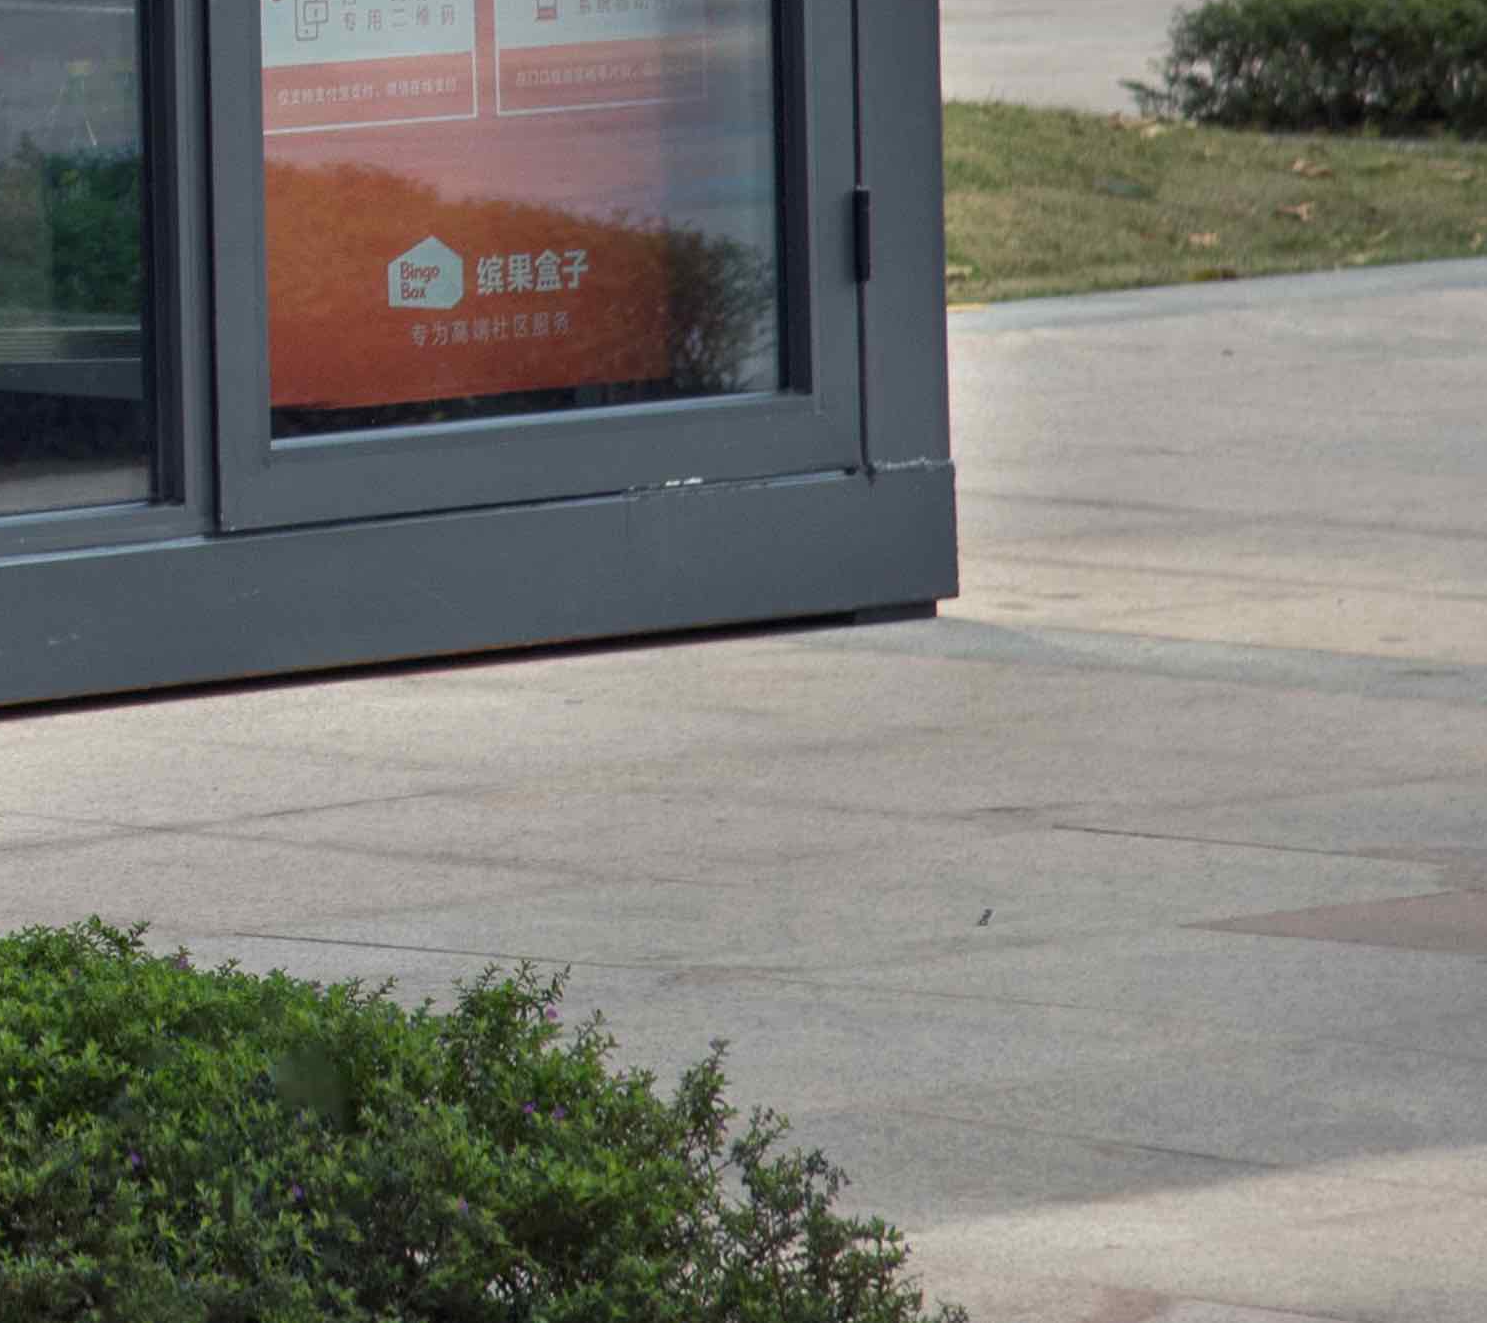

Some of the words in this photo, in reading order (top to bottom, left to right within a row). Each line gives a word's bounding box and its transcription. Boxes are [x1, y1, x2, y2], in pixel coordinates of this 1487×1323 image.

[400, 261, 439, 283] Bingo
[476, 249, 590, 296] 缤果盒子
[401, 282, 427, 301] Box
